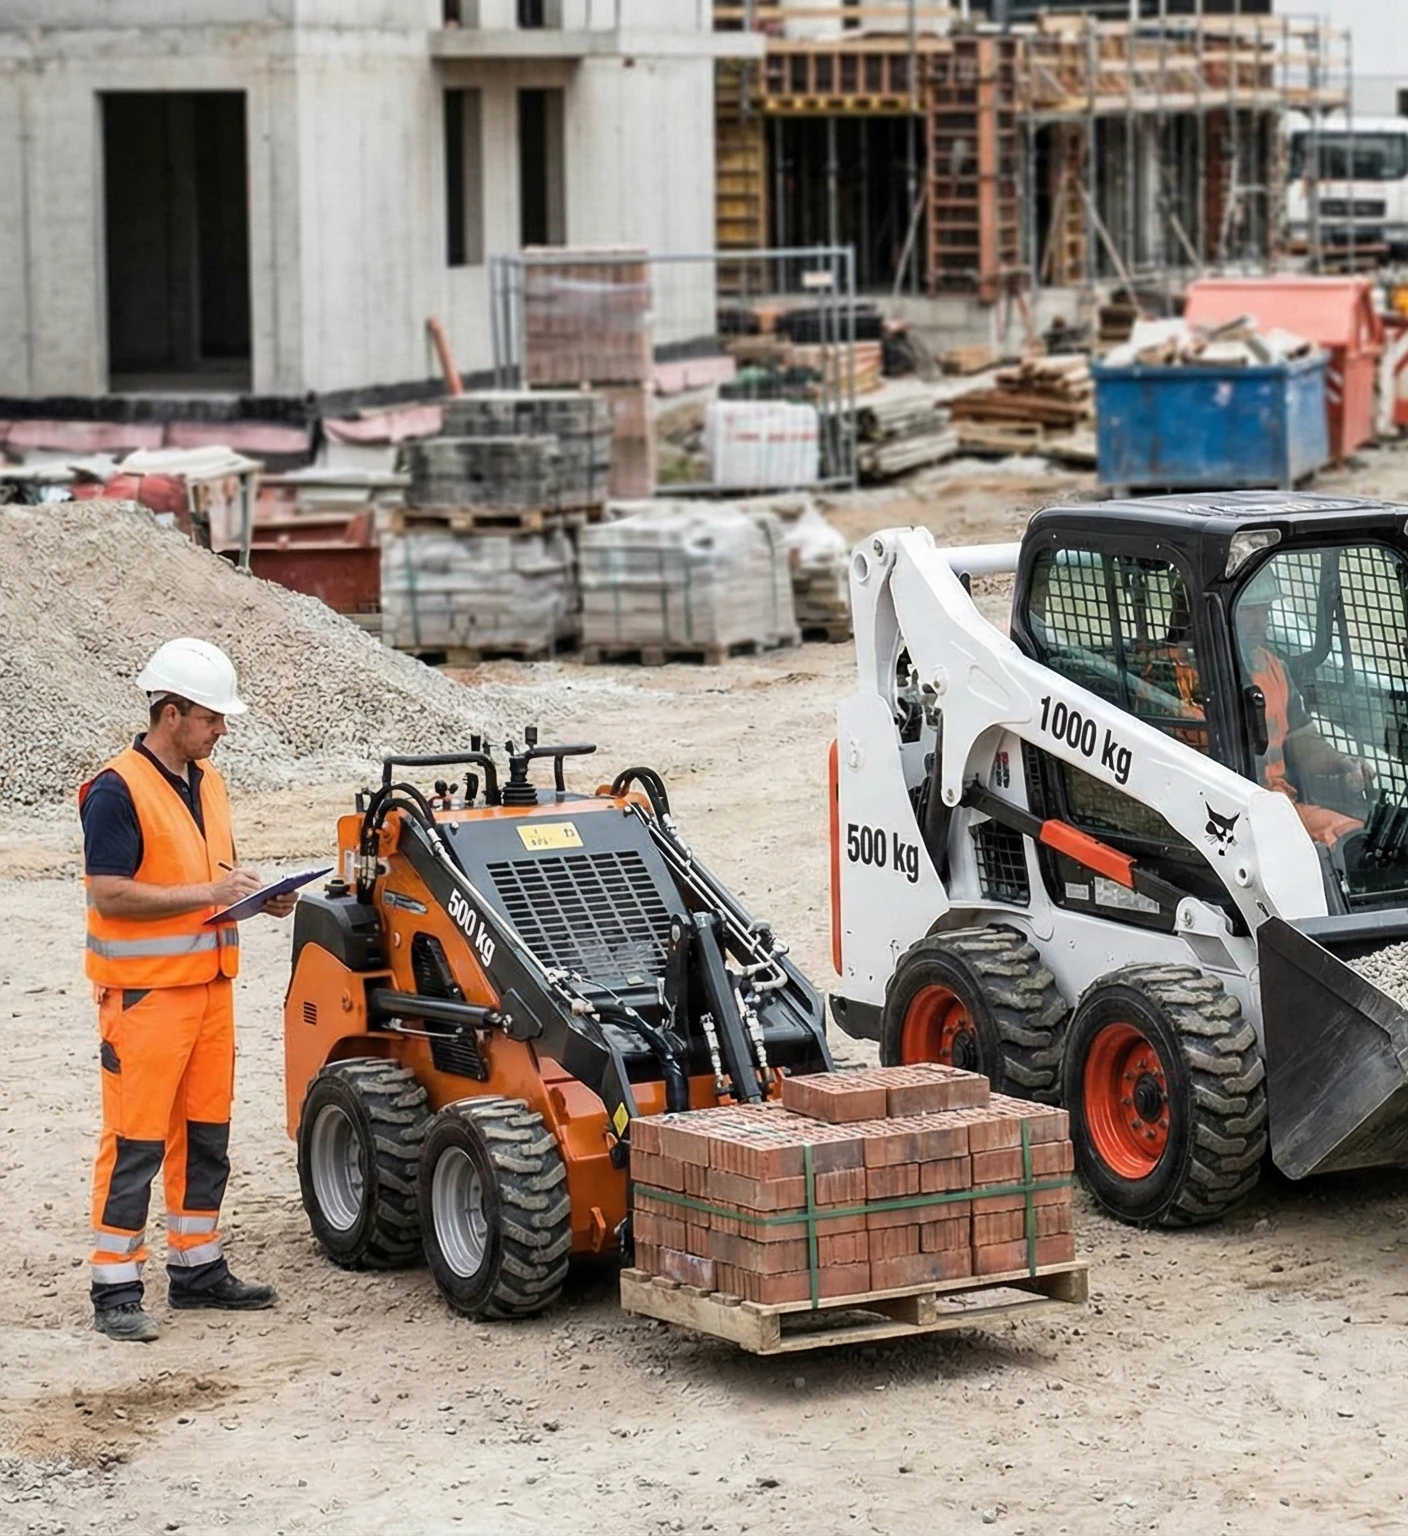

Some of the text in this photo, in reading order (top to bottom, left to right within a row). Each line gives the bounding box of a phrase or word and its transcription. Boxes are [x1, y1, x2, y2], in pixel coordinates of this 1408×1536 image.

[1041, 695, 1132, 785] 1000 kg
[847, 823, 919, 884] 500 kg
[448, 888, 496, 968] 500 kg
